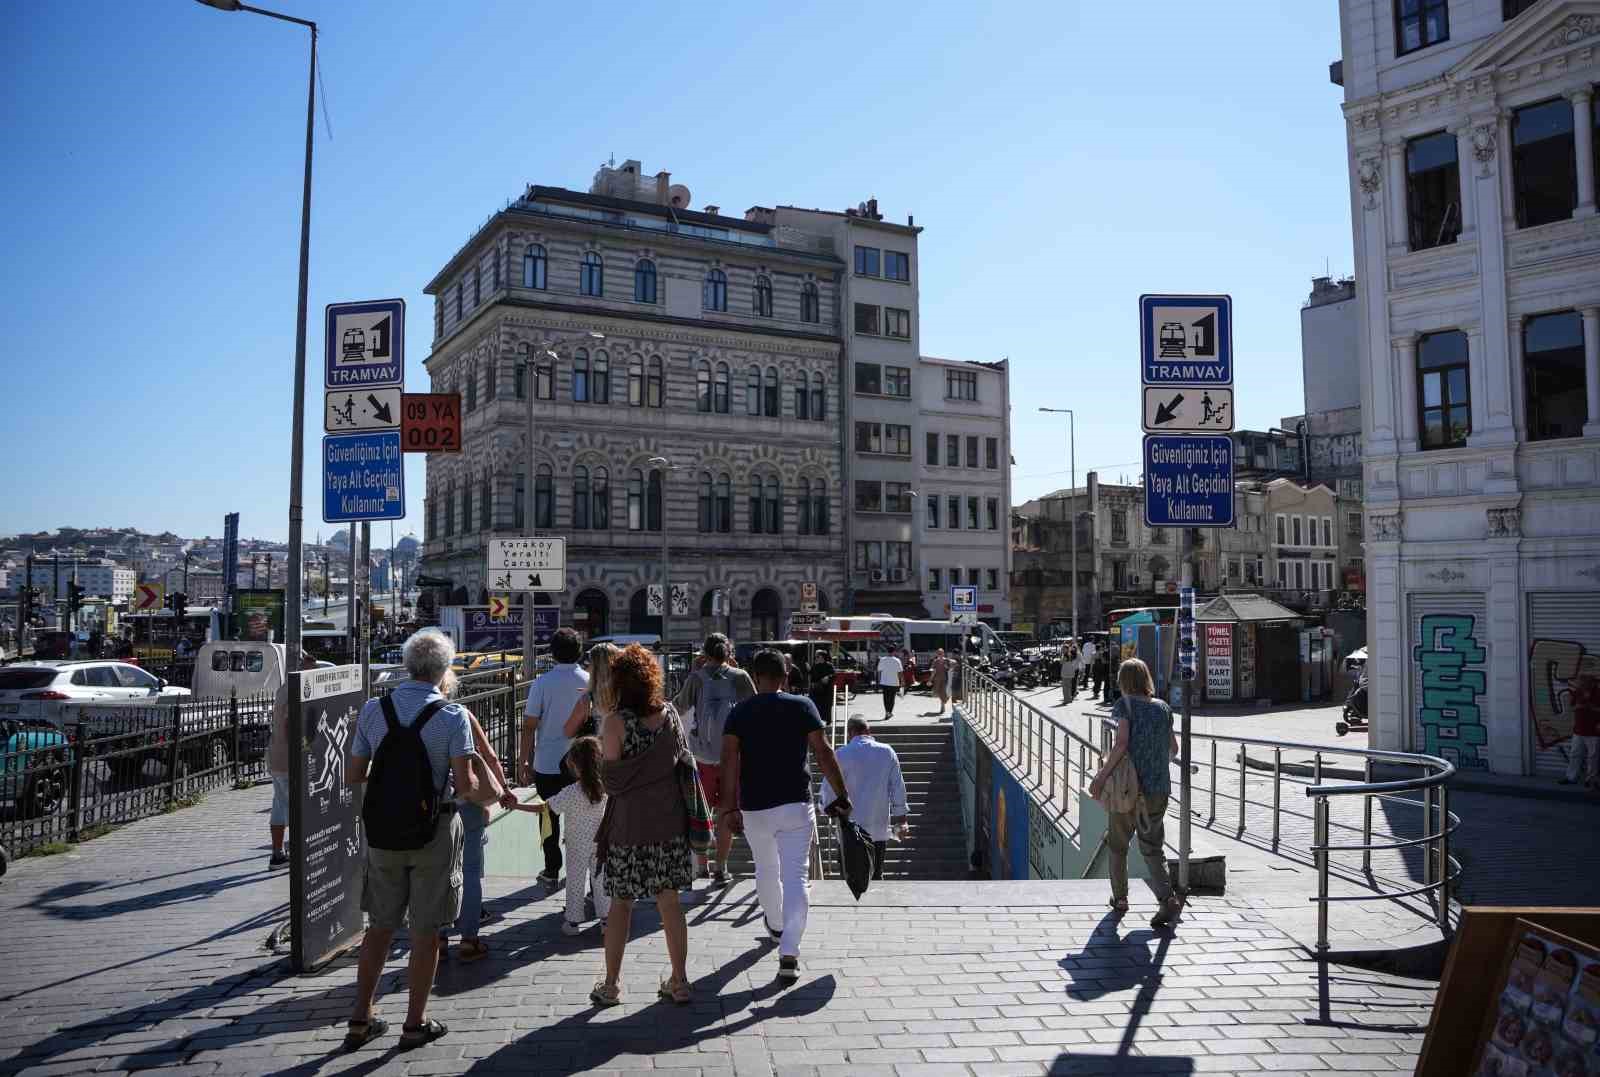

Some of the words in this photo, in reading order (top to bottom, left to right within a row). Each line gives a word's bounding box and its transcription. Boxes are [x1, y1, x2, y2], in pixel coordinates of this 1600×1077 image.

[331, 366, 397, 383] TRAMVAY
[1149, 365, 1225, 379] TRAMVAY
[407, 402, 426, 421] 09
[432, 401, 455, 420] YA
[408, 427, 454, 446] 002
[328, 443, 381, 465] Güvenliğiniz
[382, 435, 399, 464] İçin
[1151, 443, 1209, 469] Güvenliğiniz
[1210, 440, 1228, 468] İçin
[327, 470, 347, 494] Yaya
[349, 469, 362, 488] Alt
[363, 468, 400, 494] Geçidini
[1150, 473, 1172, 498] Yaya
[1175, 473, 1190, 494] Alt
[1191, 472, 1230, 498] Geçidini
[341, 495, 385, 513] Kullanınız
[1167, 498, 1214, 521] Kullanınız
[1208, 668, 1230, 676] KART
[1208, 678, 1230, 686] DOLUM
